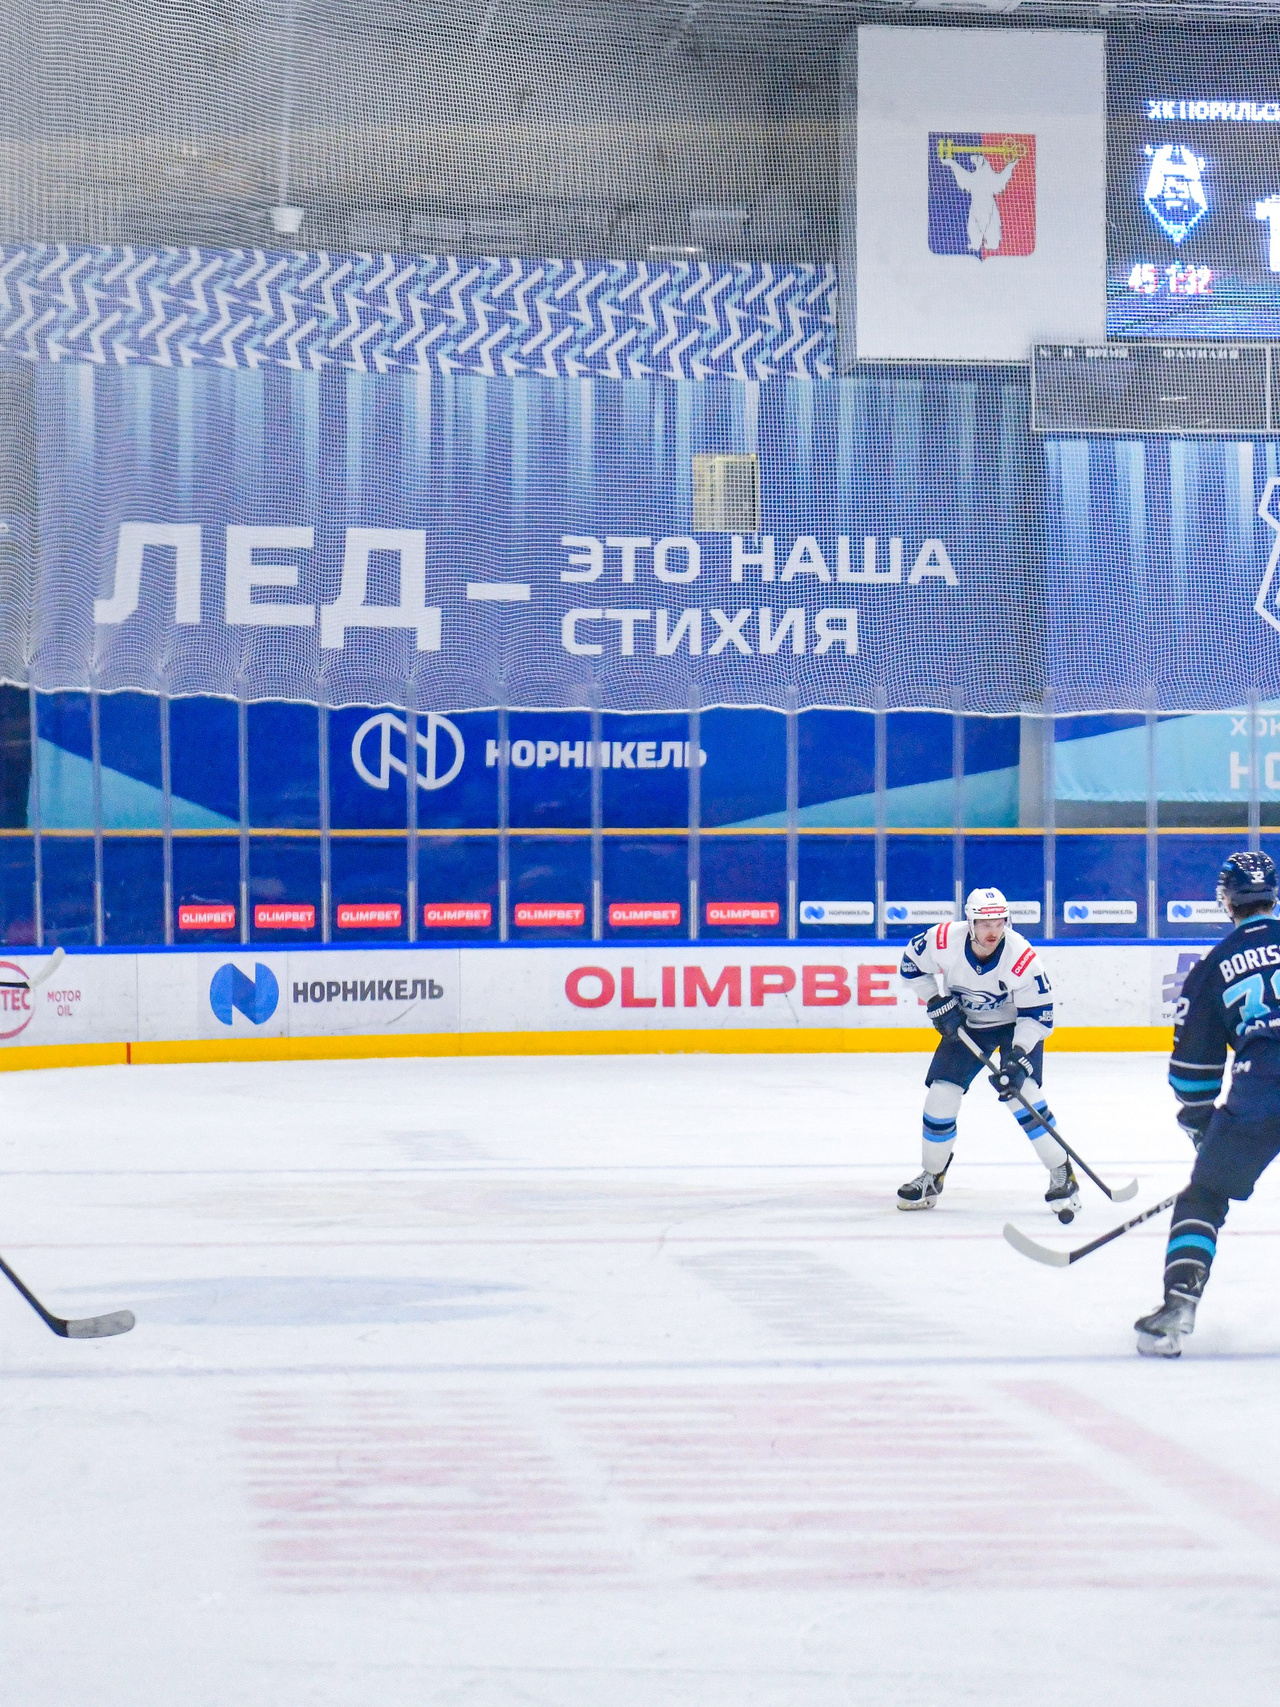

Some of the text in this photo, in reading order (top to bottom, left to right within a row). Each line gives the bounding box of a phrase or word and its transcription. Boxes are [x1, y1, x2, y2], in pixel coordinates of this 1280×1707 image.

[560, 535, 958, 586] ЭТО НАША
[94, 523, 442, 651] ЛЕД
[560, 607, 860, 657] СТИХИЯ
[486, 738, 707, 770] НОРНИКЕЛЬ
[181, 911, 235, 923] OLIMPBET
[257, 911, 315, 923] OLIMPBET
[341, 910, 400, 922] OLIMPBET
[427, 910, 490, 922] OLIMPBET
[517, 908, 582, 920] OLIMPBET
[611, 909, 677, 921] OLIMPBET
[708, 908, 776, 920] OLIMPBET
[1195, 907, 1229, 915] НОРНИКЕ
[293, 979, 444, 1003] НОРНИКЕЛЬ
[564, 965, 930, 1009] OLIMPBE
[47, 990, 81, 1002] MOTOR
[57, 1005, 73, 1016] OIL
